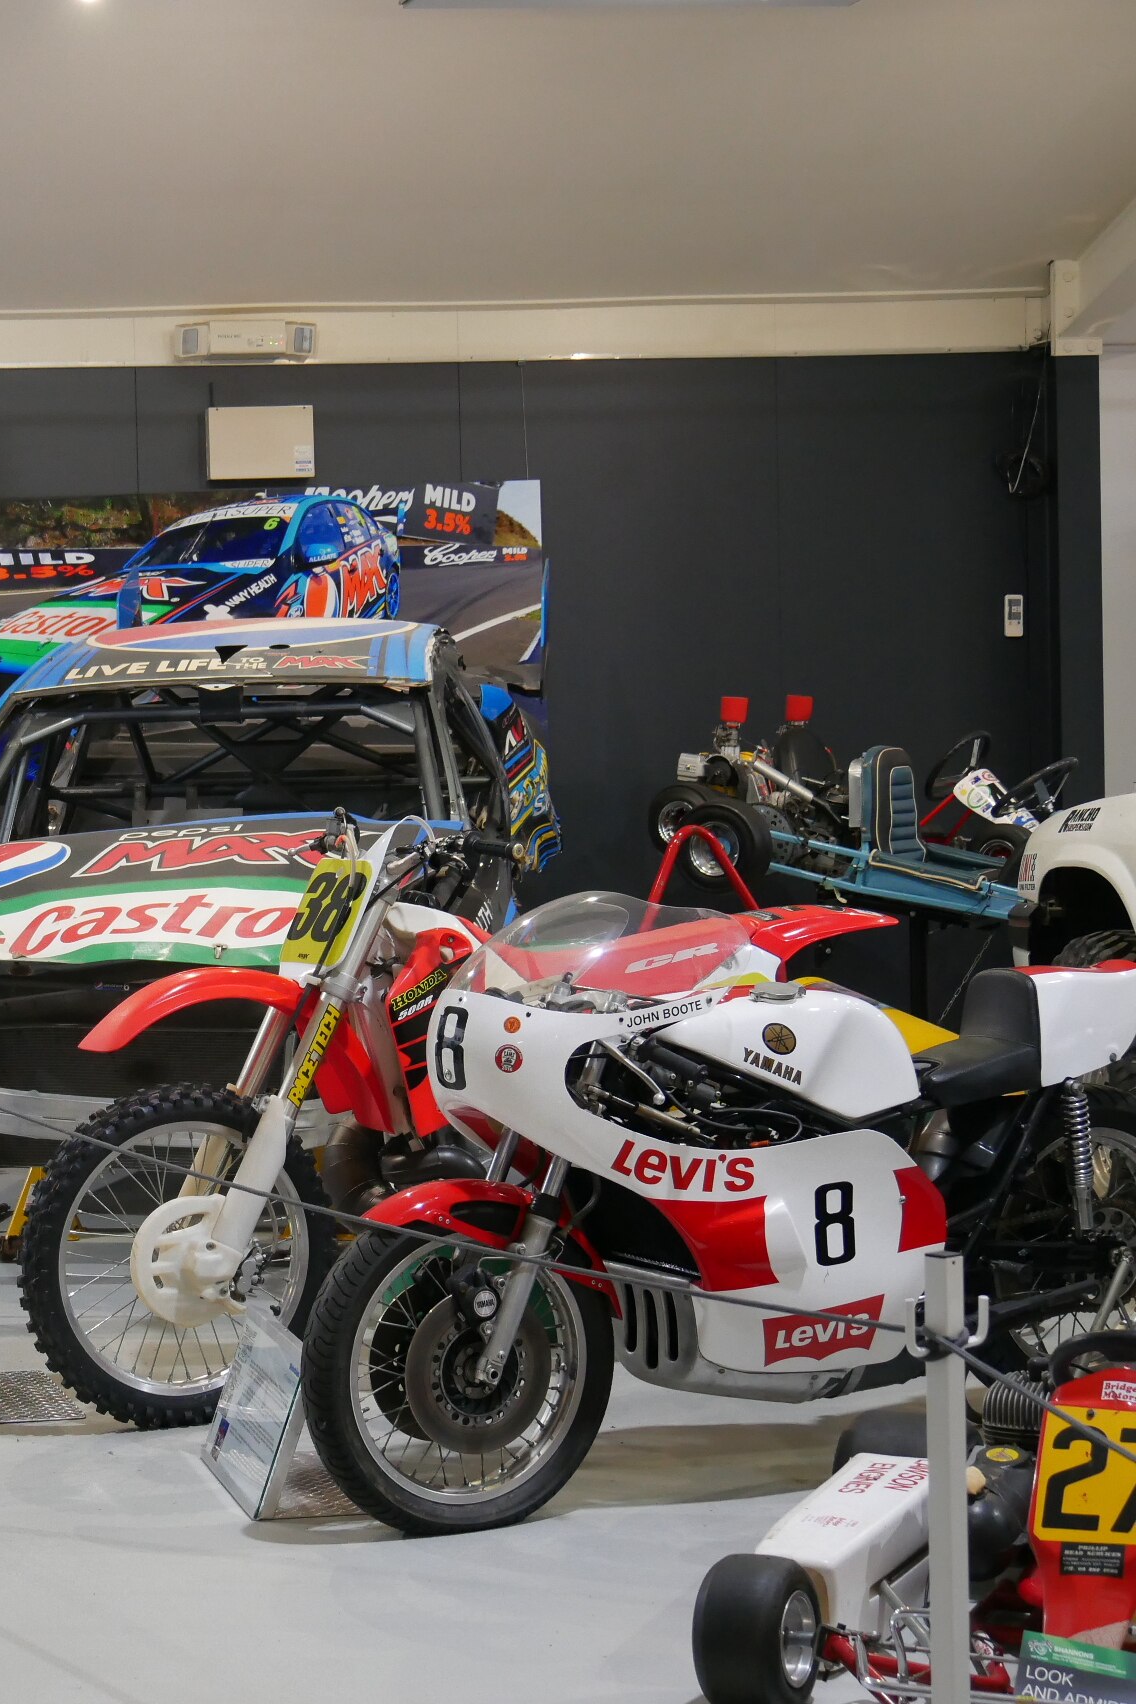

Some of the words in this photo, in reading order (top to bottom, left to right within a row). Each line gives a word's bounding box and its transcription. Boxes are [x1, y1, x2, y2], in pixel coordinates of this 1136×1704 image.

[424, 483, 476, 512] MILD
[230, 505, 292, 517] SUPER
[264, 517, 281, 530] 6
[424, 509, 472, 535] 3.5%
[424, 543, 497, 566] Coopers
[502, 547, 528, 555] MILD
[225, 589, 251, 607] NAVY
[249, 573, 278, 596] HEALTH
[64, 661, 148, 680] LIVE
[155, 658, 228, 672] LIFE
[235, 662, 267, 670] THE
[241, 656, 264, 664] TO
[272, 655, 372, 669] MAX
[119, 823, 243, 841] pepsi
[1058, 807, 1102, 833] RANCHO
[1067, 823, 1094, 832] SUSPENSION
[286, 872, 367, 942] 38
[9, 894, 299, 956] Castro
[625, 942, 720, 974] CR
[391, 968, 448, 1011] HONDA
[398, 994, 434, 1021] 500R
[627, 1011, 660, 1028] JOHN
[663, 1000, 703, 1019] BOOTE
[287, 1050, 319, 1109] RACE
[309, 1003, 341, 1057] TECH
[434, 1005, 469, 1091] 8
[743, 1047, 802, 1085] YAMAHA
[814, 1181, 855, 1266] 8
[1053, 1645, 1094, 1660] SHANNONS
[1026, 1665, 1073, 1687] LOOK
[1022, 1684, 1059, 1701] AND
